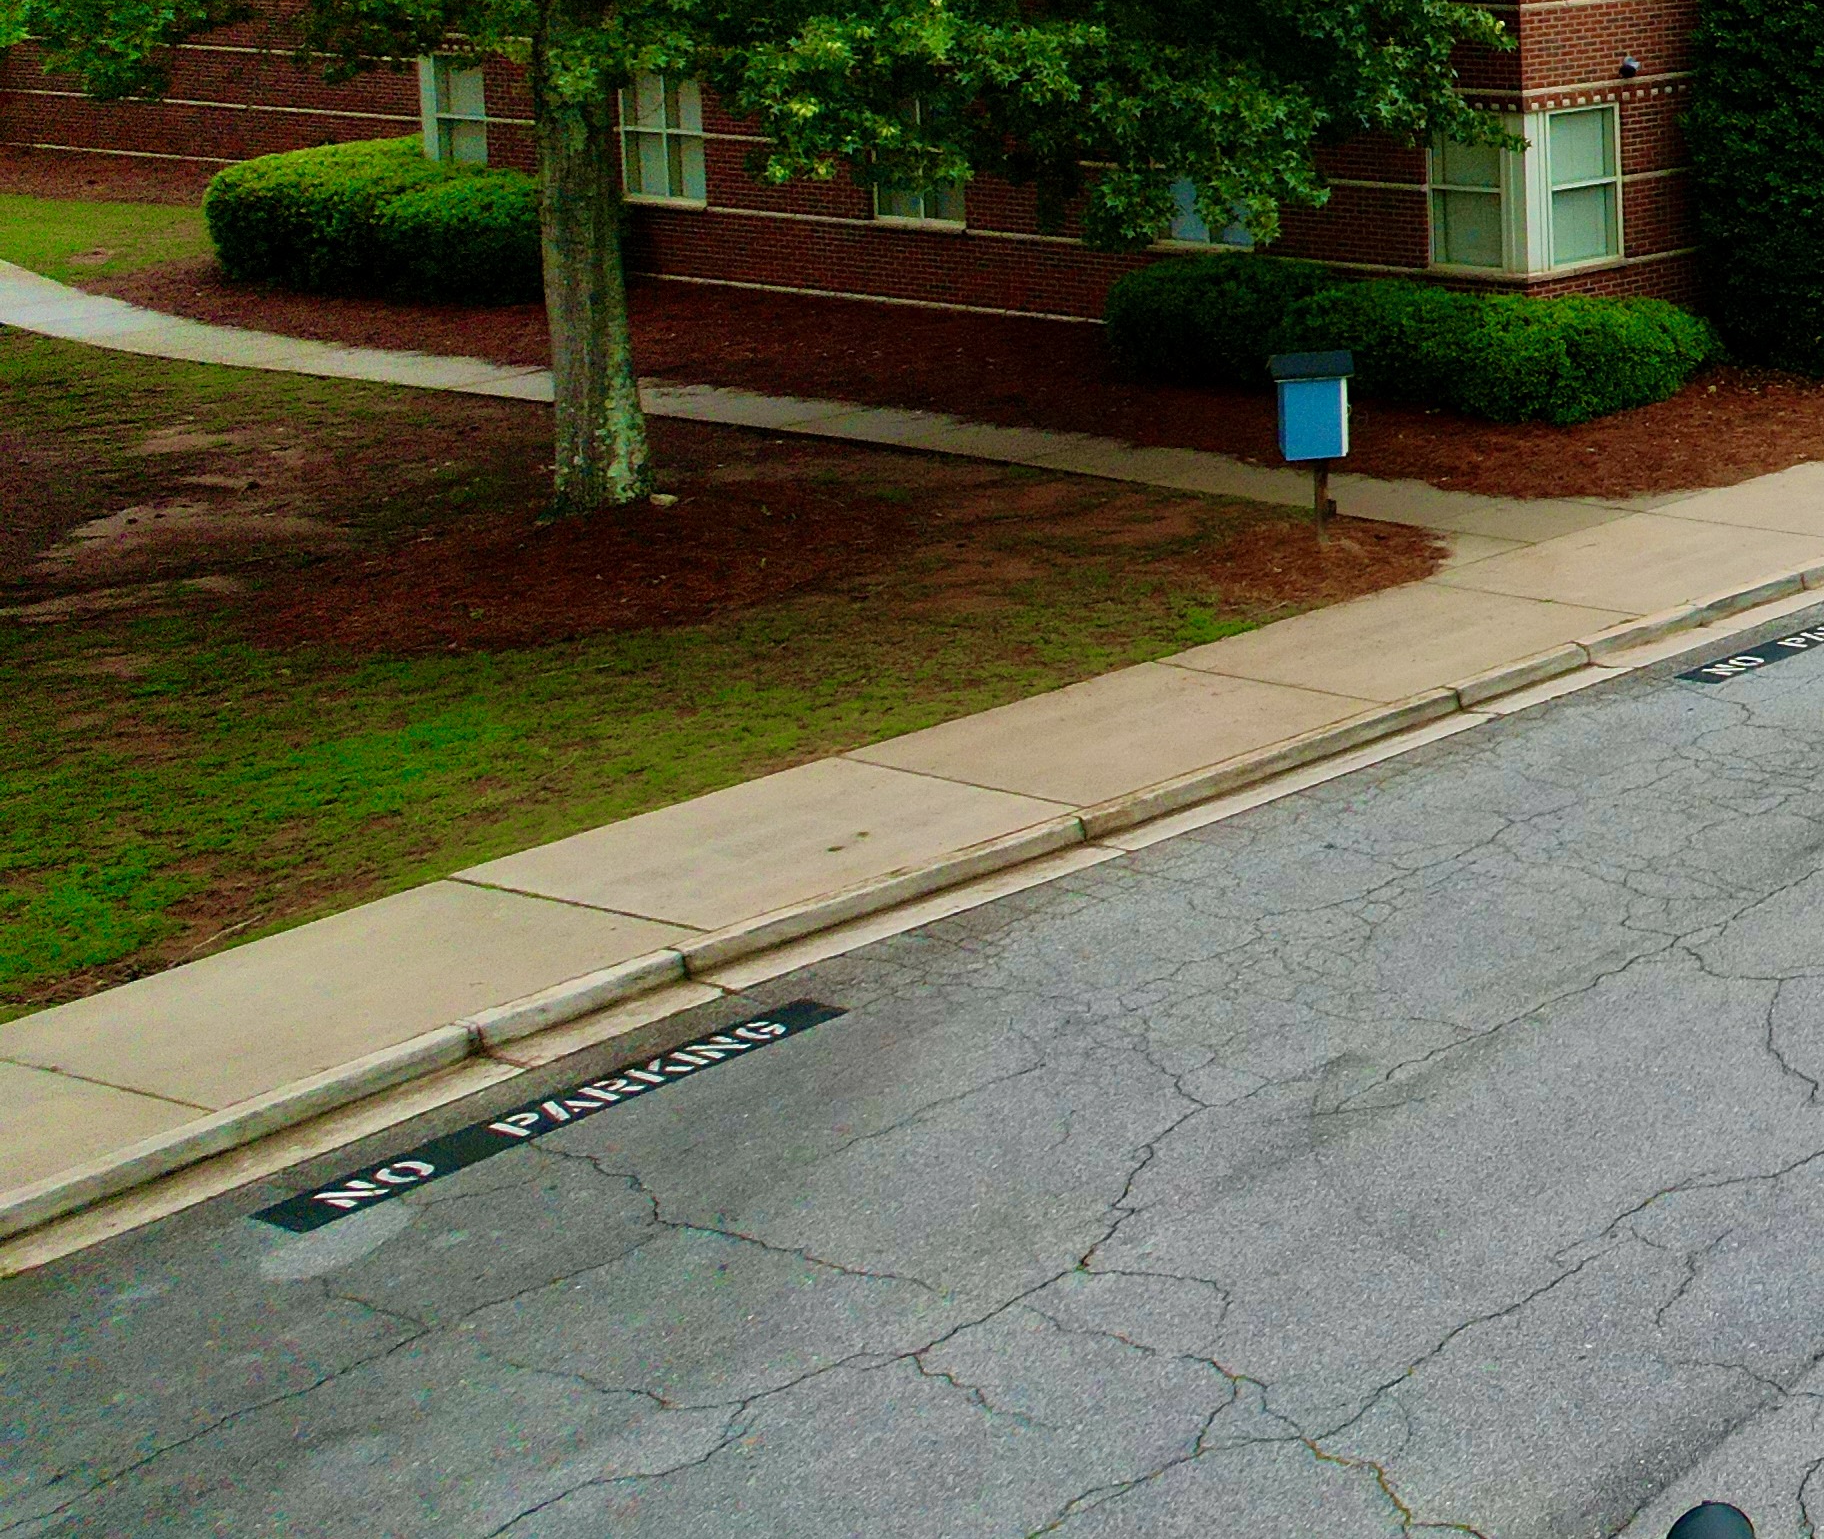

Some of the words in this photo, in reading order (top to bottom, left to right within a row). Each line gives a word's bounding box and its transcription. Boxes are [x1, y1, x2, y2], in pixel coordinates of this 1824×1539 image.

[1701, 655, 1765, 676] NO
[313, 1160, 435, 1209] NO
[488, 1021, 788, 1139] PARKING
